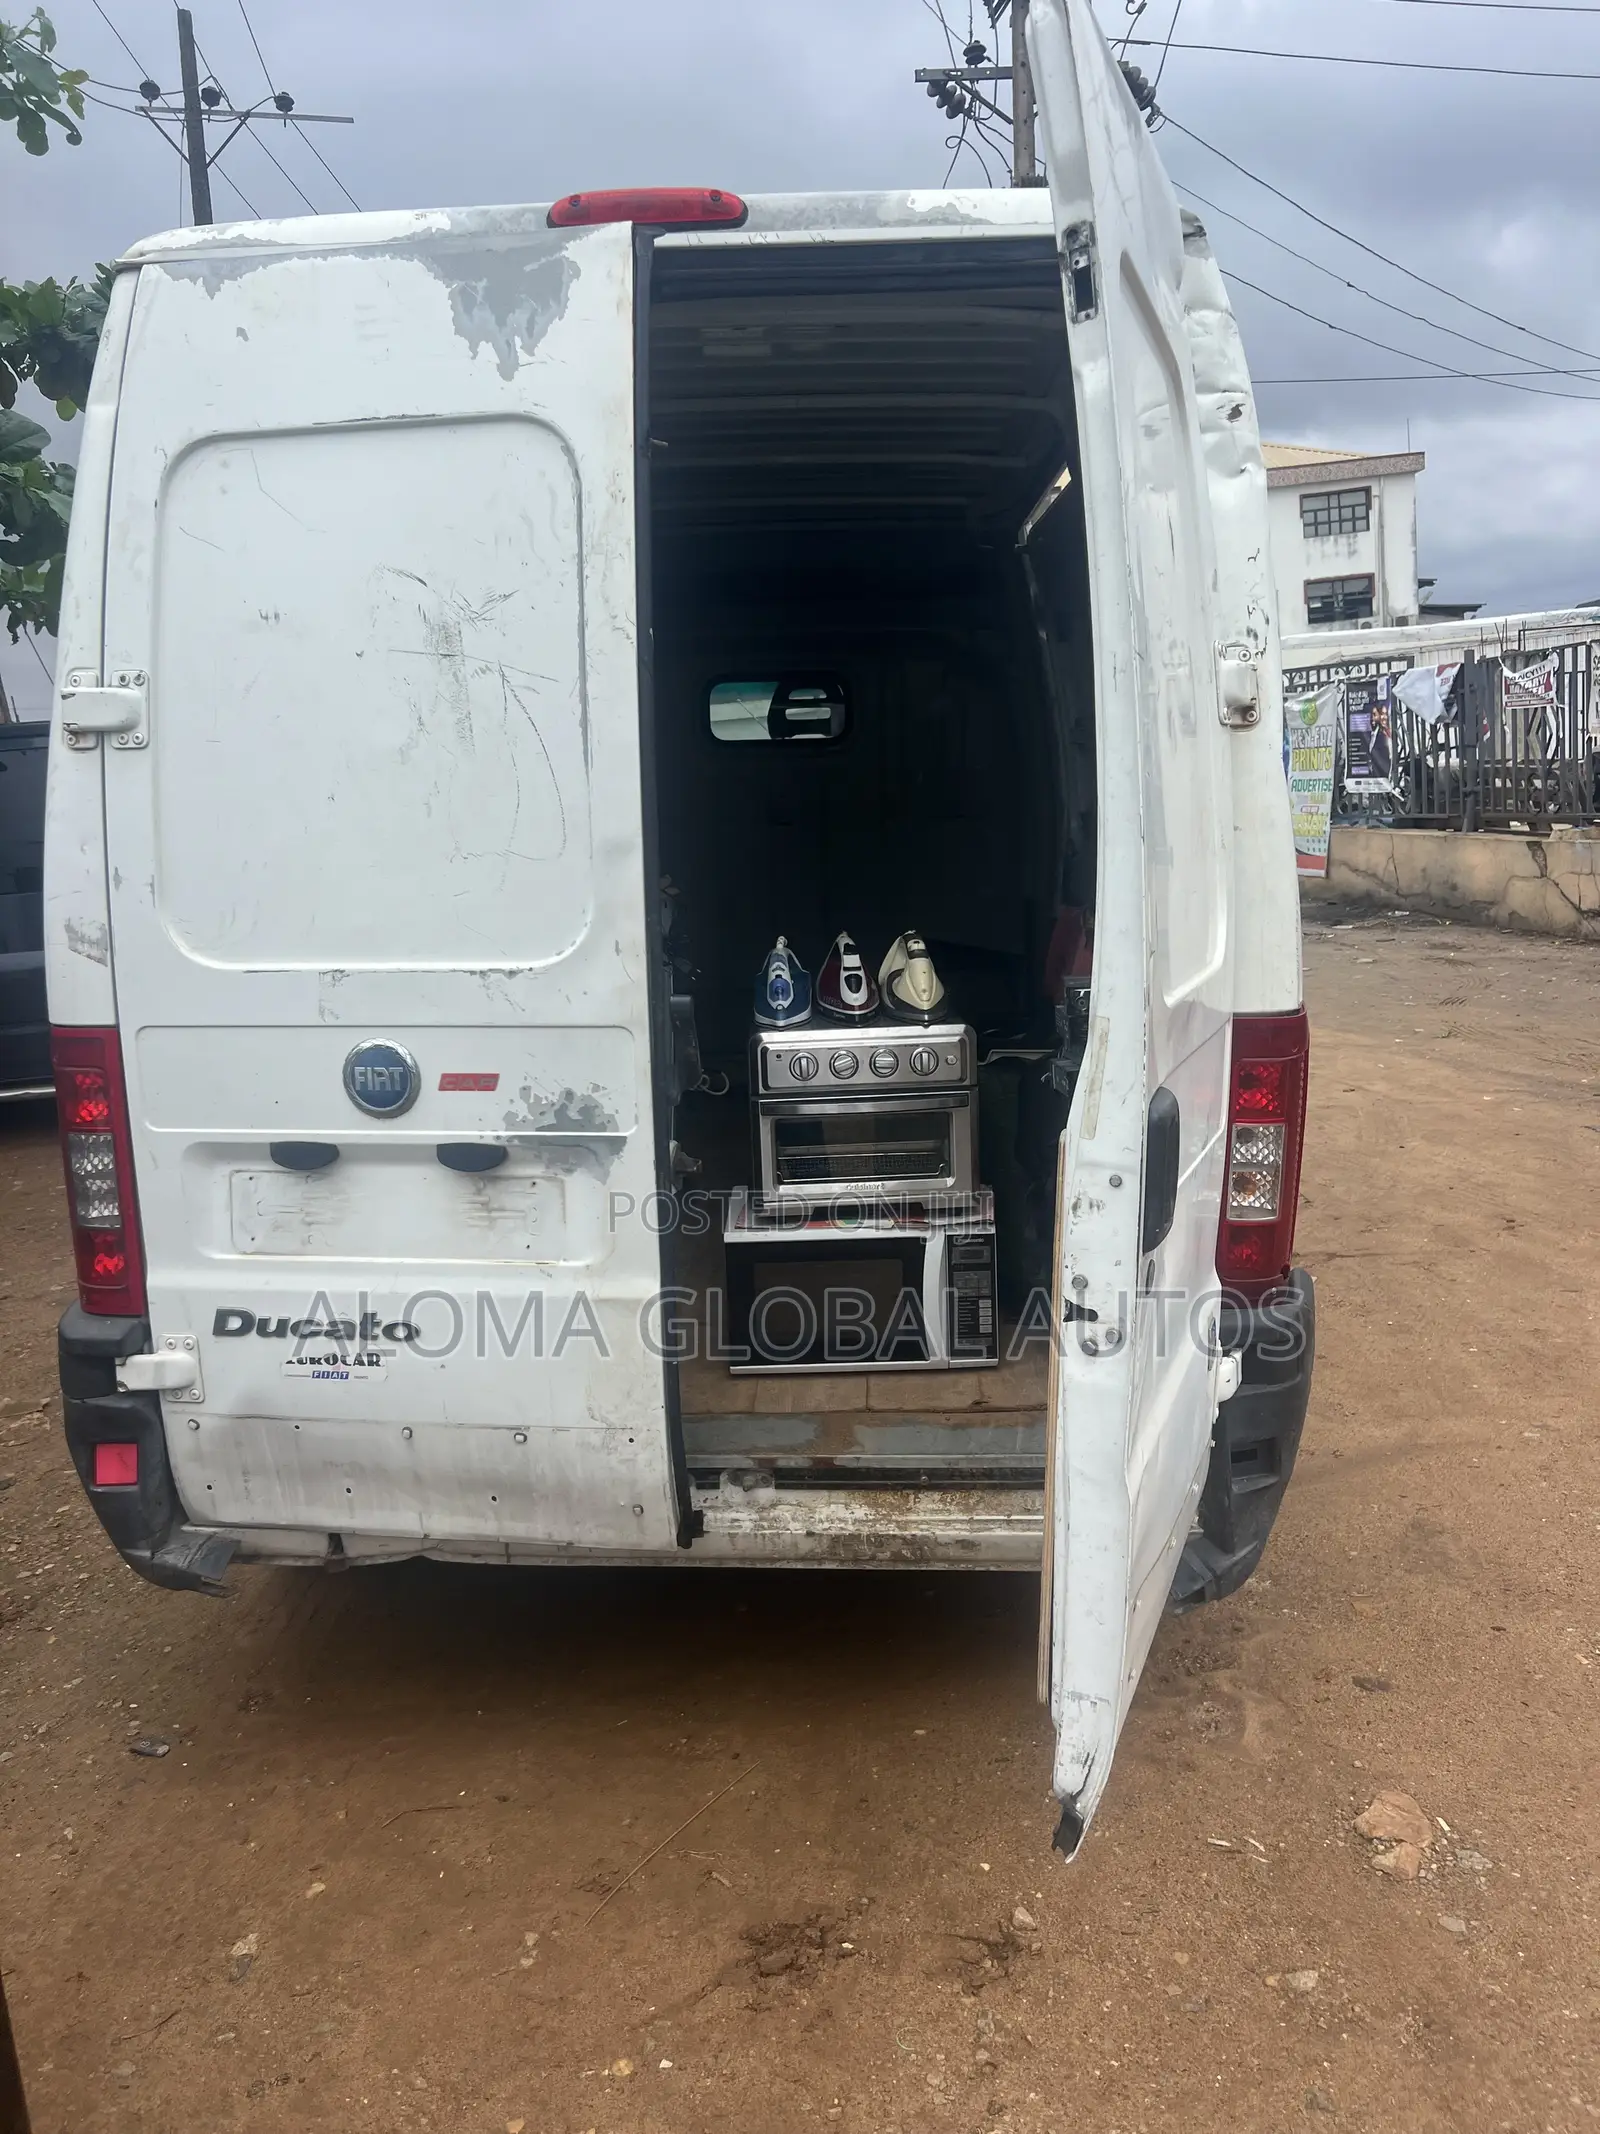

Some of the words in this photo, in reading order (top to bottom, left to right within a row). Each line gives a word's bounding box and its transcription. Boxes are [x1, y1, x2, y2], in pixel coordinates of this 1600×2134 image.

[1291, 747, 1332, 772] PRINTS
[1291, 777, 1332, 792] ADVERTISE
[353, 1066, 404, 1091] FIAT
[212, 1306, 421, 1342] Ducato
[312, 1370, 350, 1379] FIAT
